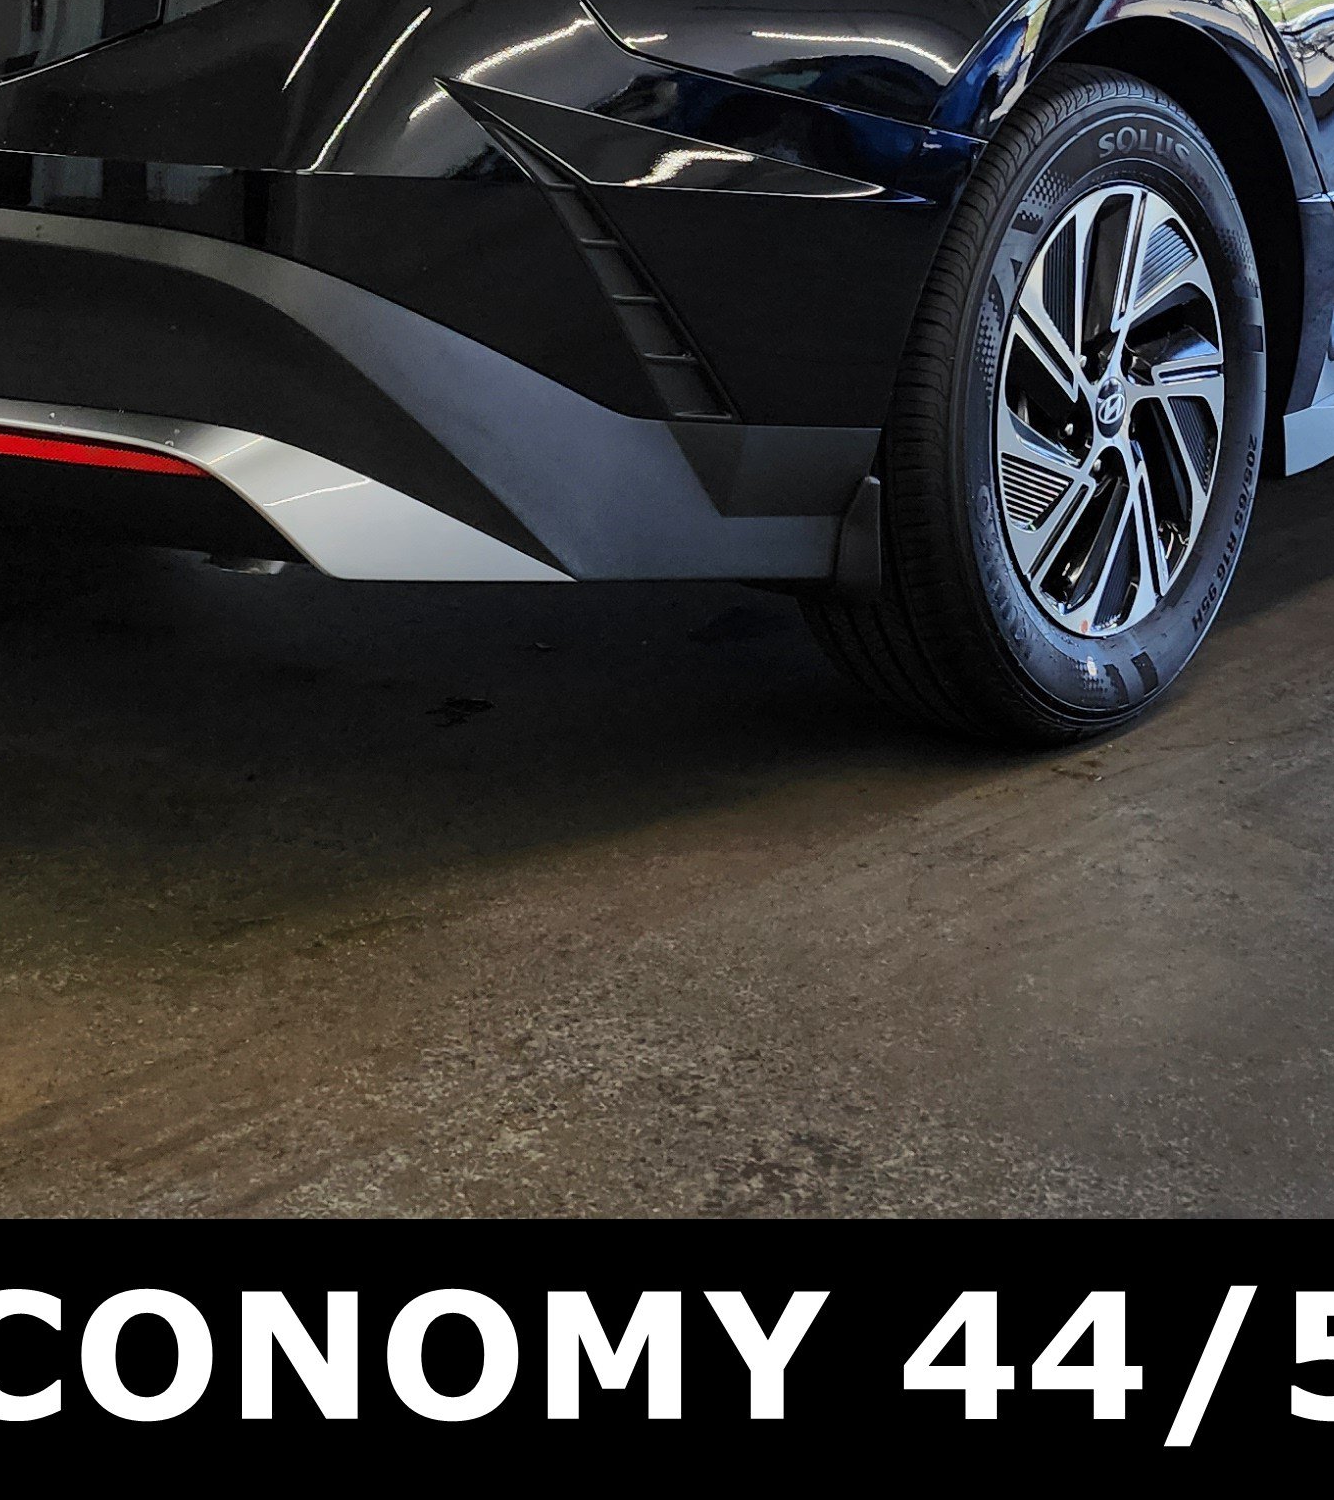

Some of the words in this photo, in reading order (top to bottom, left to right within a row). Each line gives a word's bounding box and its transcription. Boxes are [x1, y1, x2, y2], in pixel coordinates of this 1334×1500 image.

[1098, 126, 1190, 167] SOLUS
[1234, 434, 1258, 527] 205/65
[1191, 583, 1218, 632] 95H
